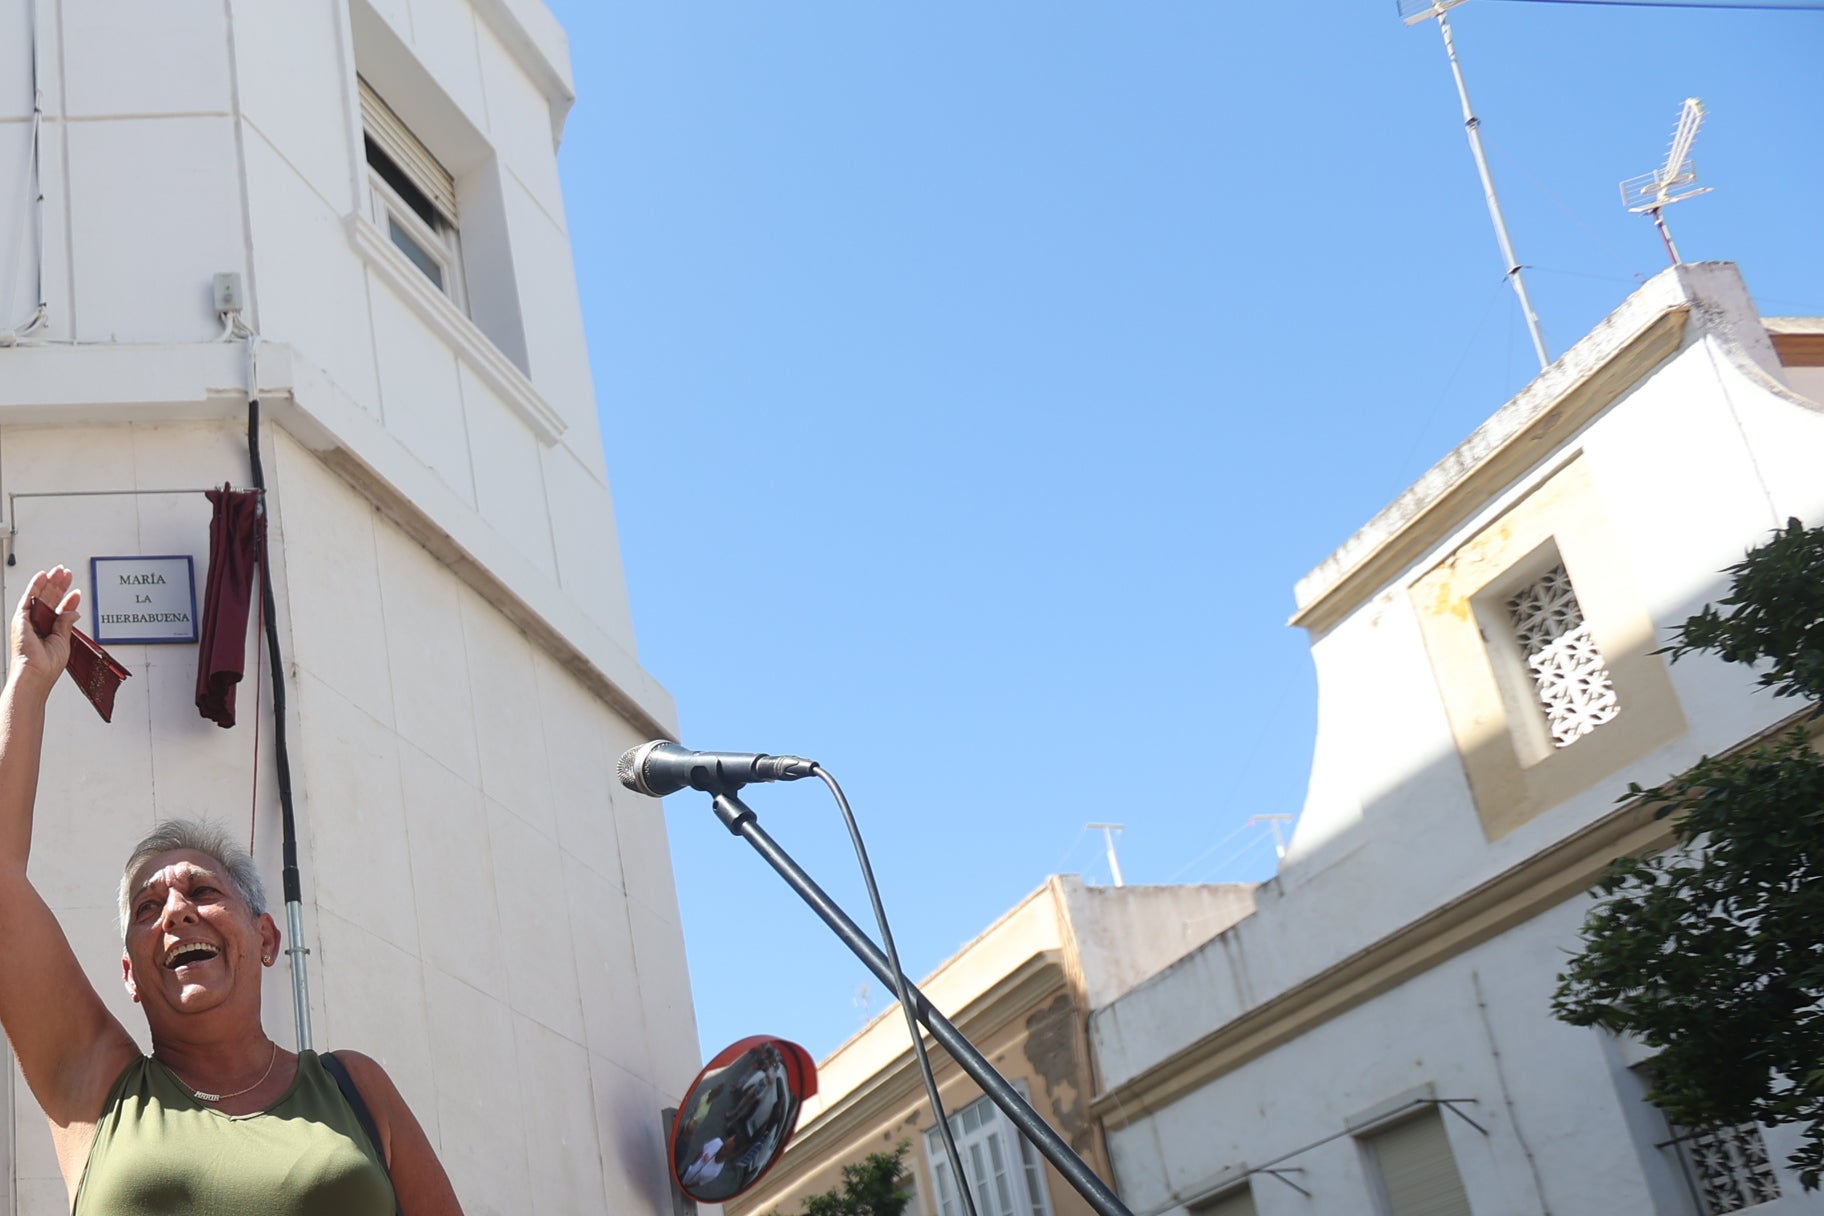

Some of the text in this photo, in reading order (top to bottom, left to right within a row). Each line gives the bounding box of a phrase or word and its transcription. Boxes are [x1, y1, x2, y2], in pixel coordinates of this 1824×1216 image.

[119, 572, 166, 585] MARÍA
[135, 594, 152, 604] LA
[100, 612, 190, 624] HIERBABUENA
